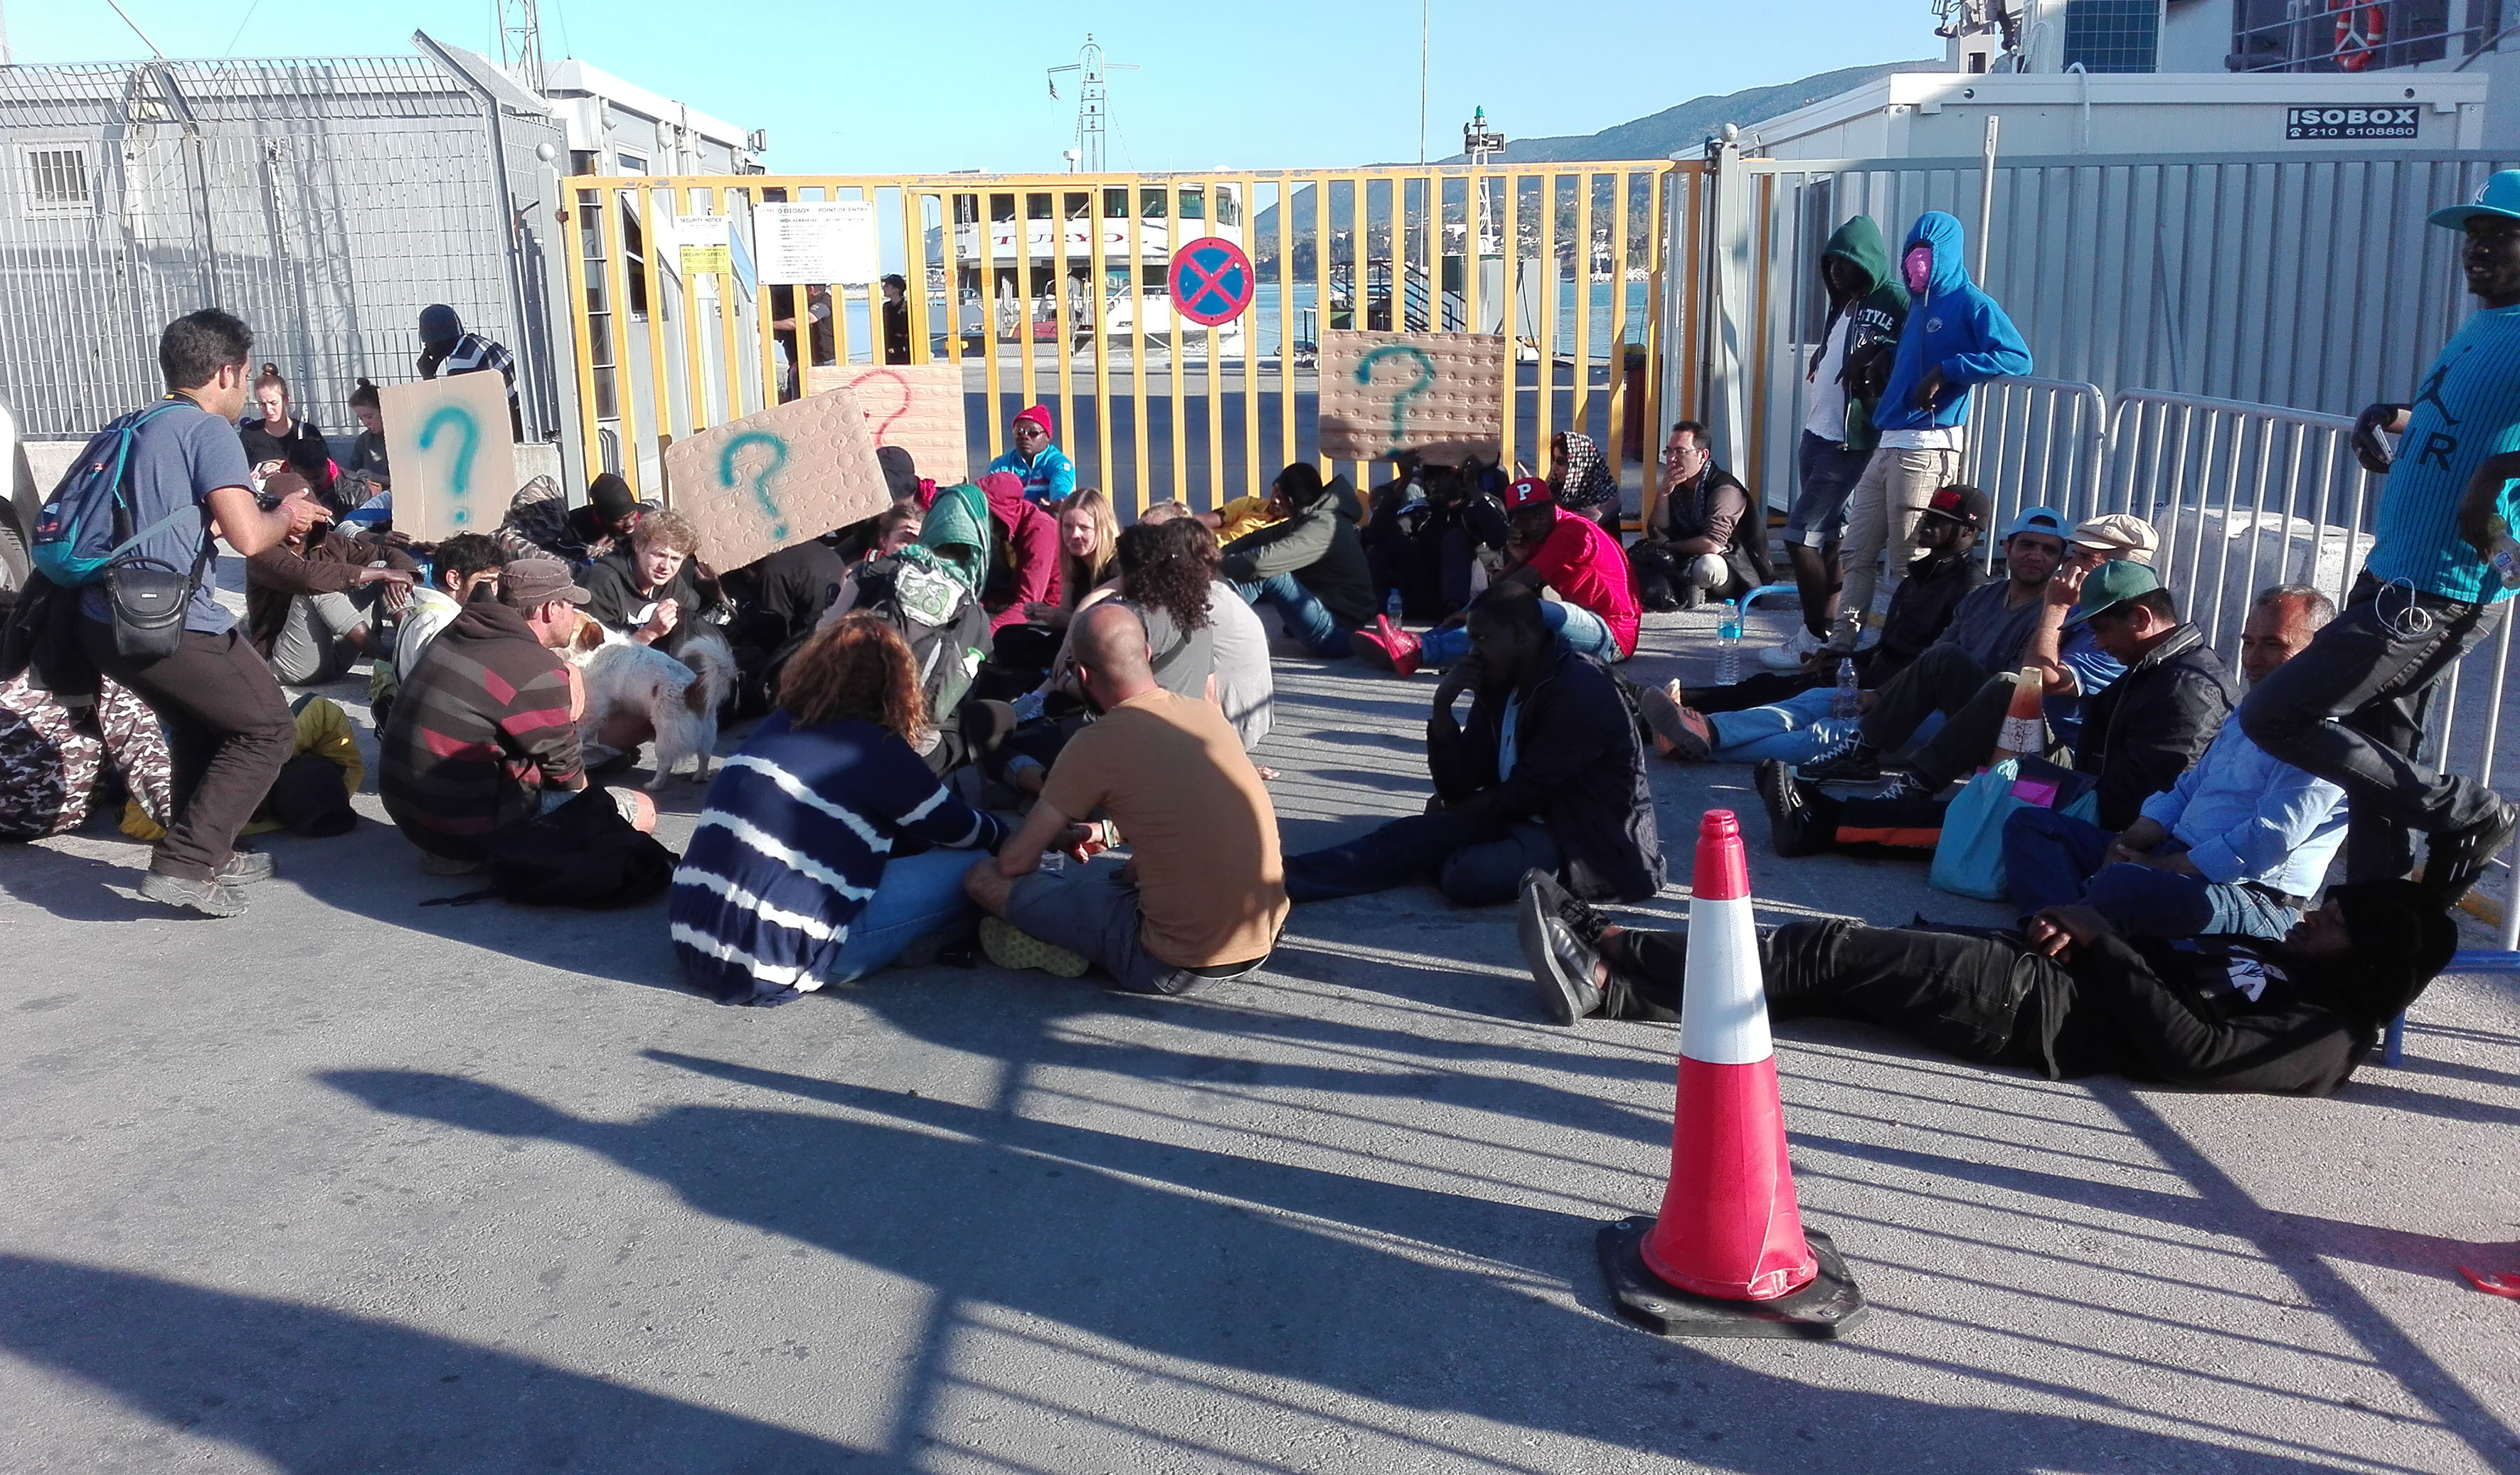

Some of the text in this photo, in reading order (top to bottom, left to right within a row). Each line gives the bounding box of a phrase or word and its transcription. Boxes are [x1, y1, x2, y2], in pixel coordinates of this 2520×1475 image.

[2290, 109, 2415, 125] ISOBOX
[2308, 127, 2415, 136] 210 6108880
[1858, 309, 1894, 331] STYLE
[418, 405, 482, 523] ?
[719, 430, 790, 540] ?
[1516, 483, 1531, 501] P
